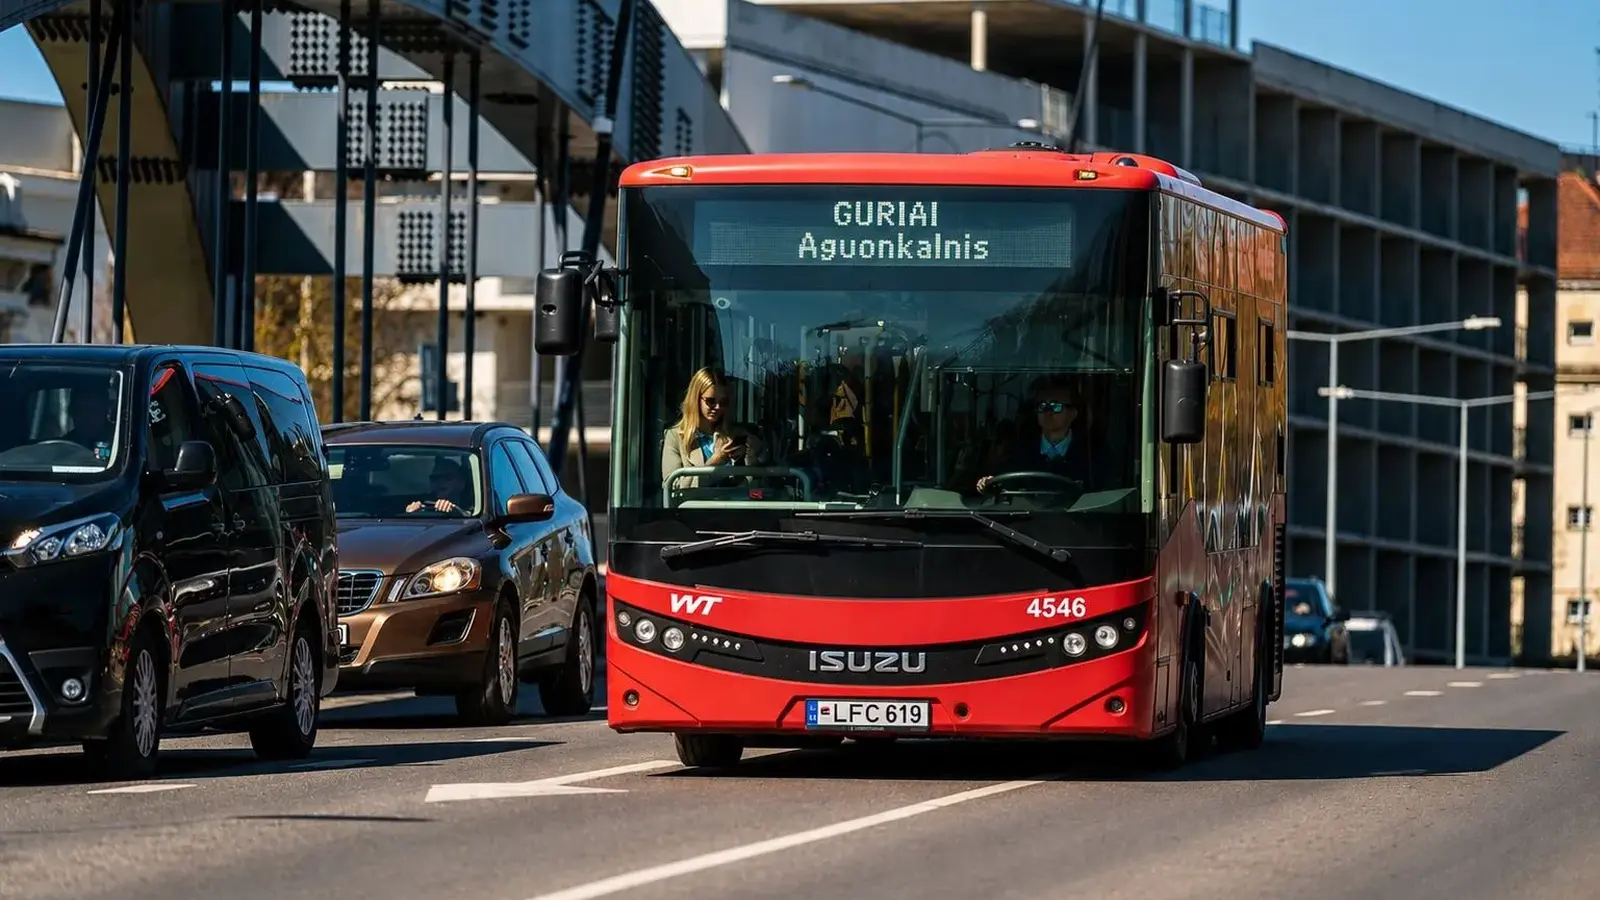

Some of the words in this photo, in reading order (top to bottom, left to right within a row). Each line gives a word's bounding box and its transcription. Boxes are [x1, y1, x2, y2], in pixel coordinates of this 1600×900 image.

[833, 201, 938, 227] GURIAI
[798, 232, 989, 261] Aguonkalnis
[1026, 597, 1086, 618] 4546
[809, 650, 926, 673] ISUZU
[833, 703, 880, 723] LFC
[885, 704, 922, 724] 619
